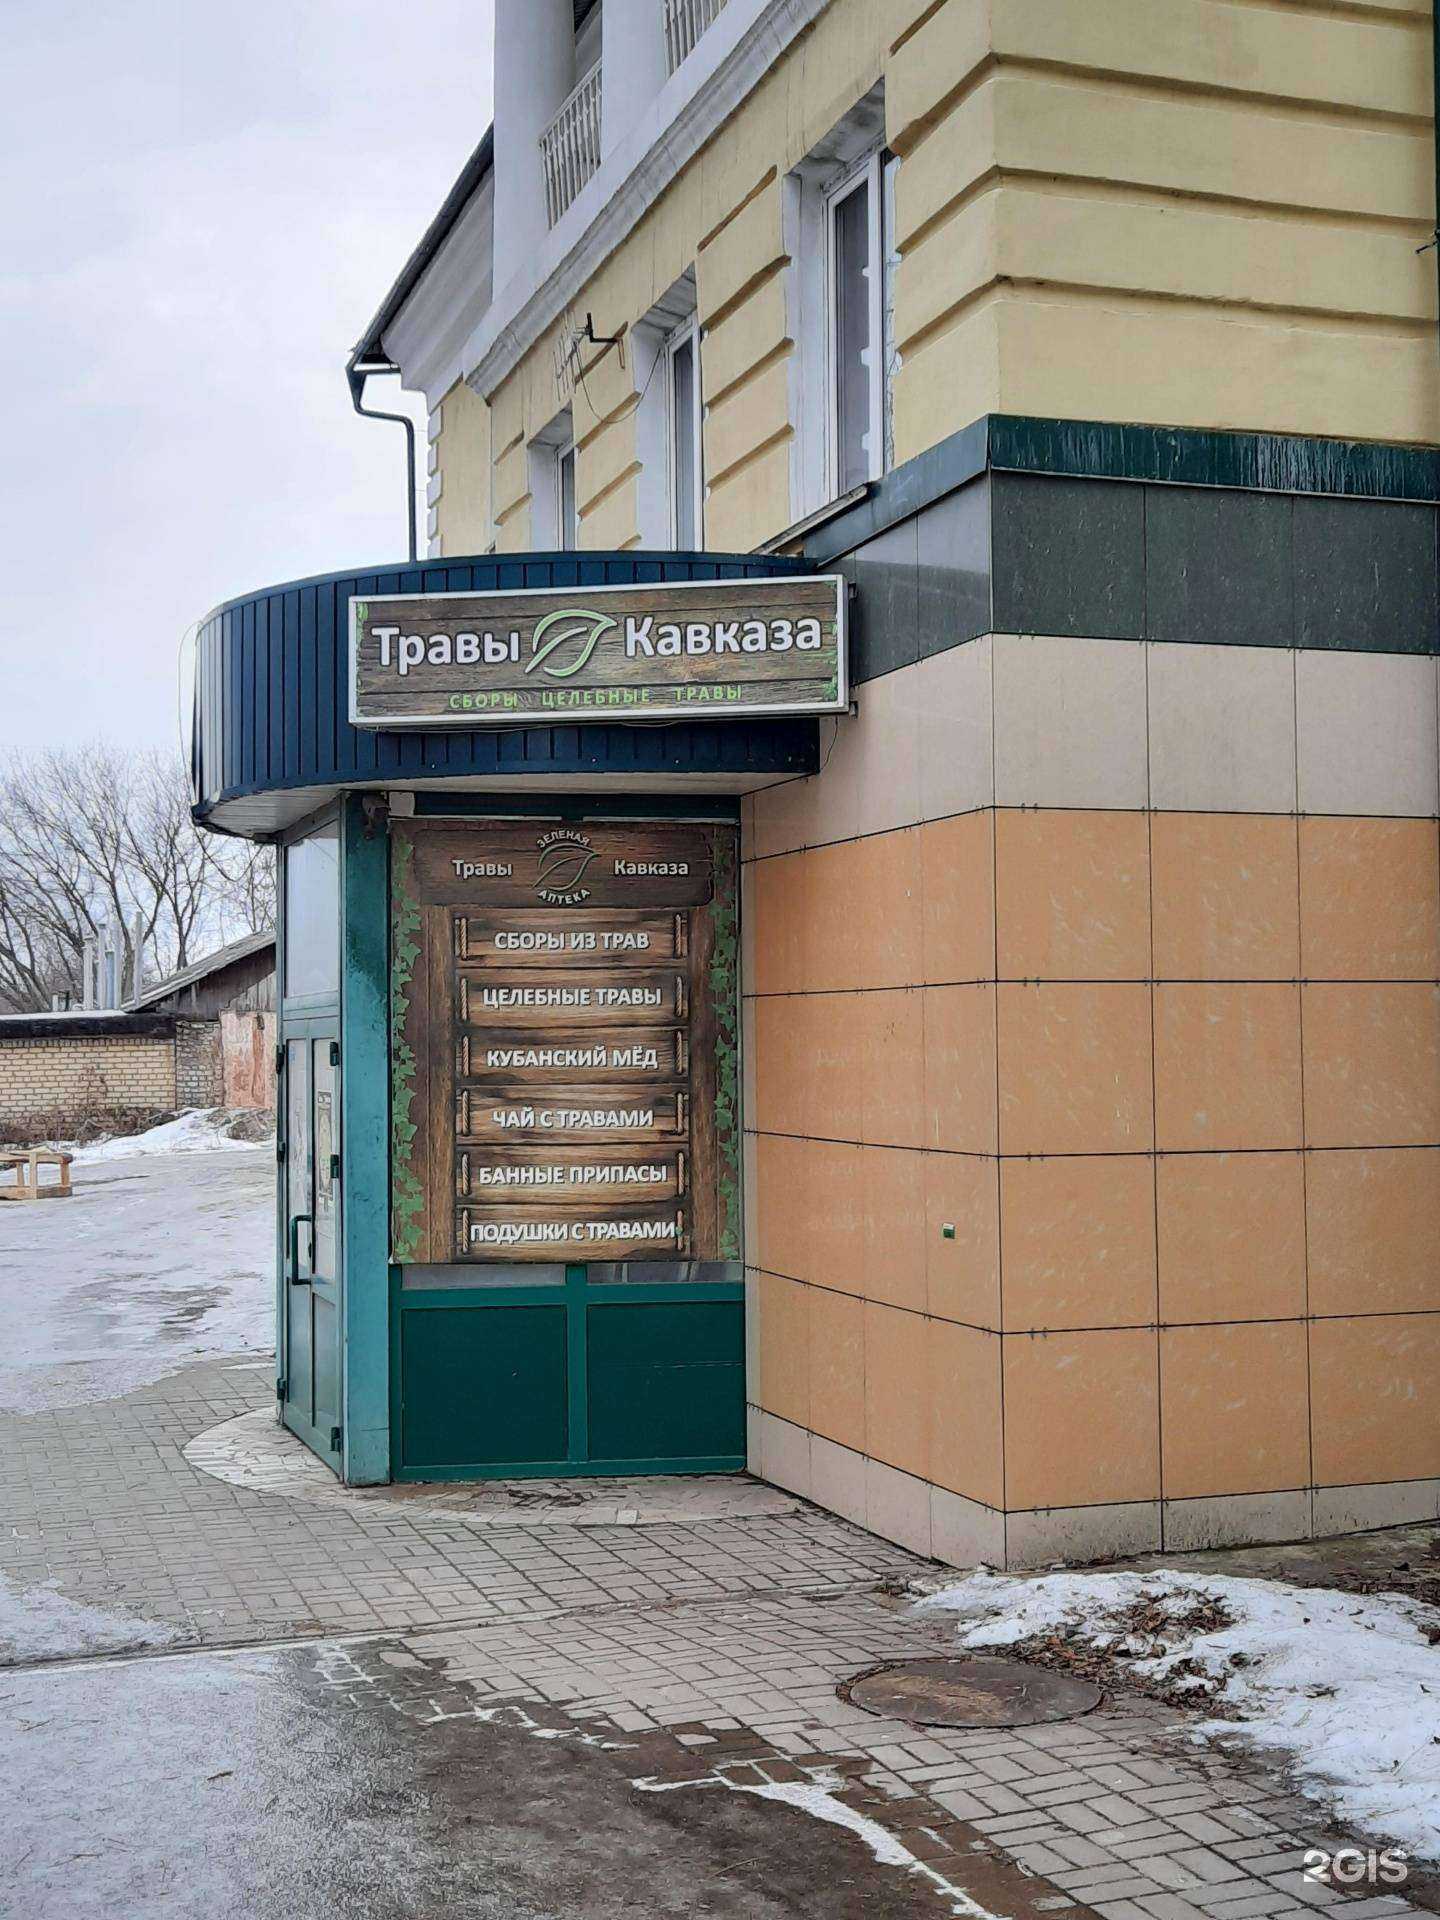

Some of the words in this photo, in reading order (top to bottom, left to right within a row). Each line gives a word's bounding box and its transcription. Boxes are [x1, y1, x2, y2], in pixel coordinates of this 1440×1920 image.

[371, 626, 519, 675] Травы
[625, 616, 822, 658] Кавказа
[449, 692, 518, 709] СБОРЫ
[541, 688, 651, 707] ЦЕЛЕБНЫЕ
[674, 685, 743, 702] ТРАВЫ
[536, 830, 591, 849] ЗЕЛЕНАЯ
[452, 859, 513, 879] Травы
[614, 859, 690, 876] Кавказа
[537, 887, 592, 905] АПТЕКА
[494, 931, 566, 950] СБОРЫ
[570, 932, 597, 950] ИЗ
[602, 932, 650, 950] ТРАВ
[483, 989, 592, 1007] ЦЕЛЕБНЫЕ
[595, 988, 662, 1006] ТРАВЫ
[487, 1046, 608, 1067] КУБАНСКИЙ
[613, 1047, 659, 1069] МЁД
[493, 1107, 536, 1128] ЧАЙ
[540, 1111, 555, 1128] С
[556, 1110, 654, 1128] ТРАВАМИ
[479, 1166, 564, 1184] БАННЫЕ
[569, 1165, 668, 1184] ПРИПАСЫ
[470, 1223, 569, 1244] ПОДУШКИ
[572, 1223, 586, 1240] С
[586, 1221, 677, 1240] ТРАВАМИ
